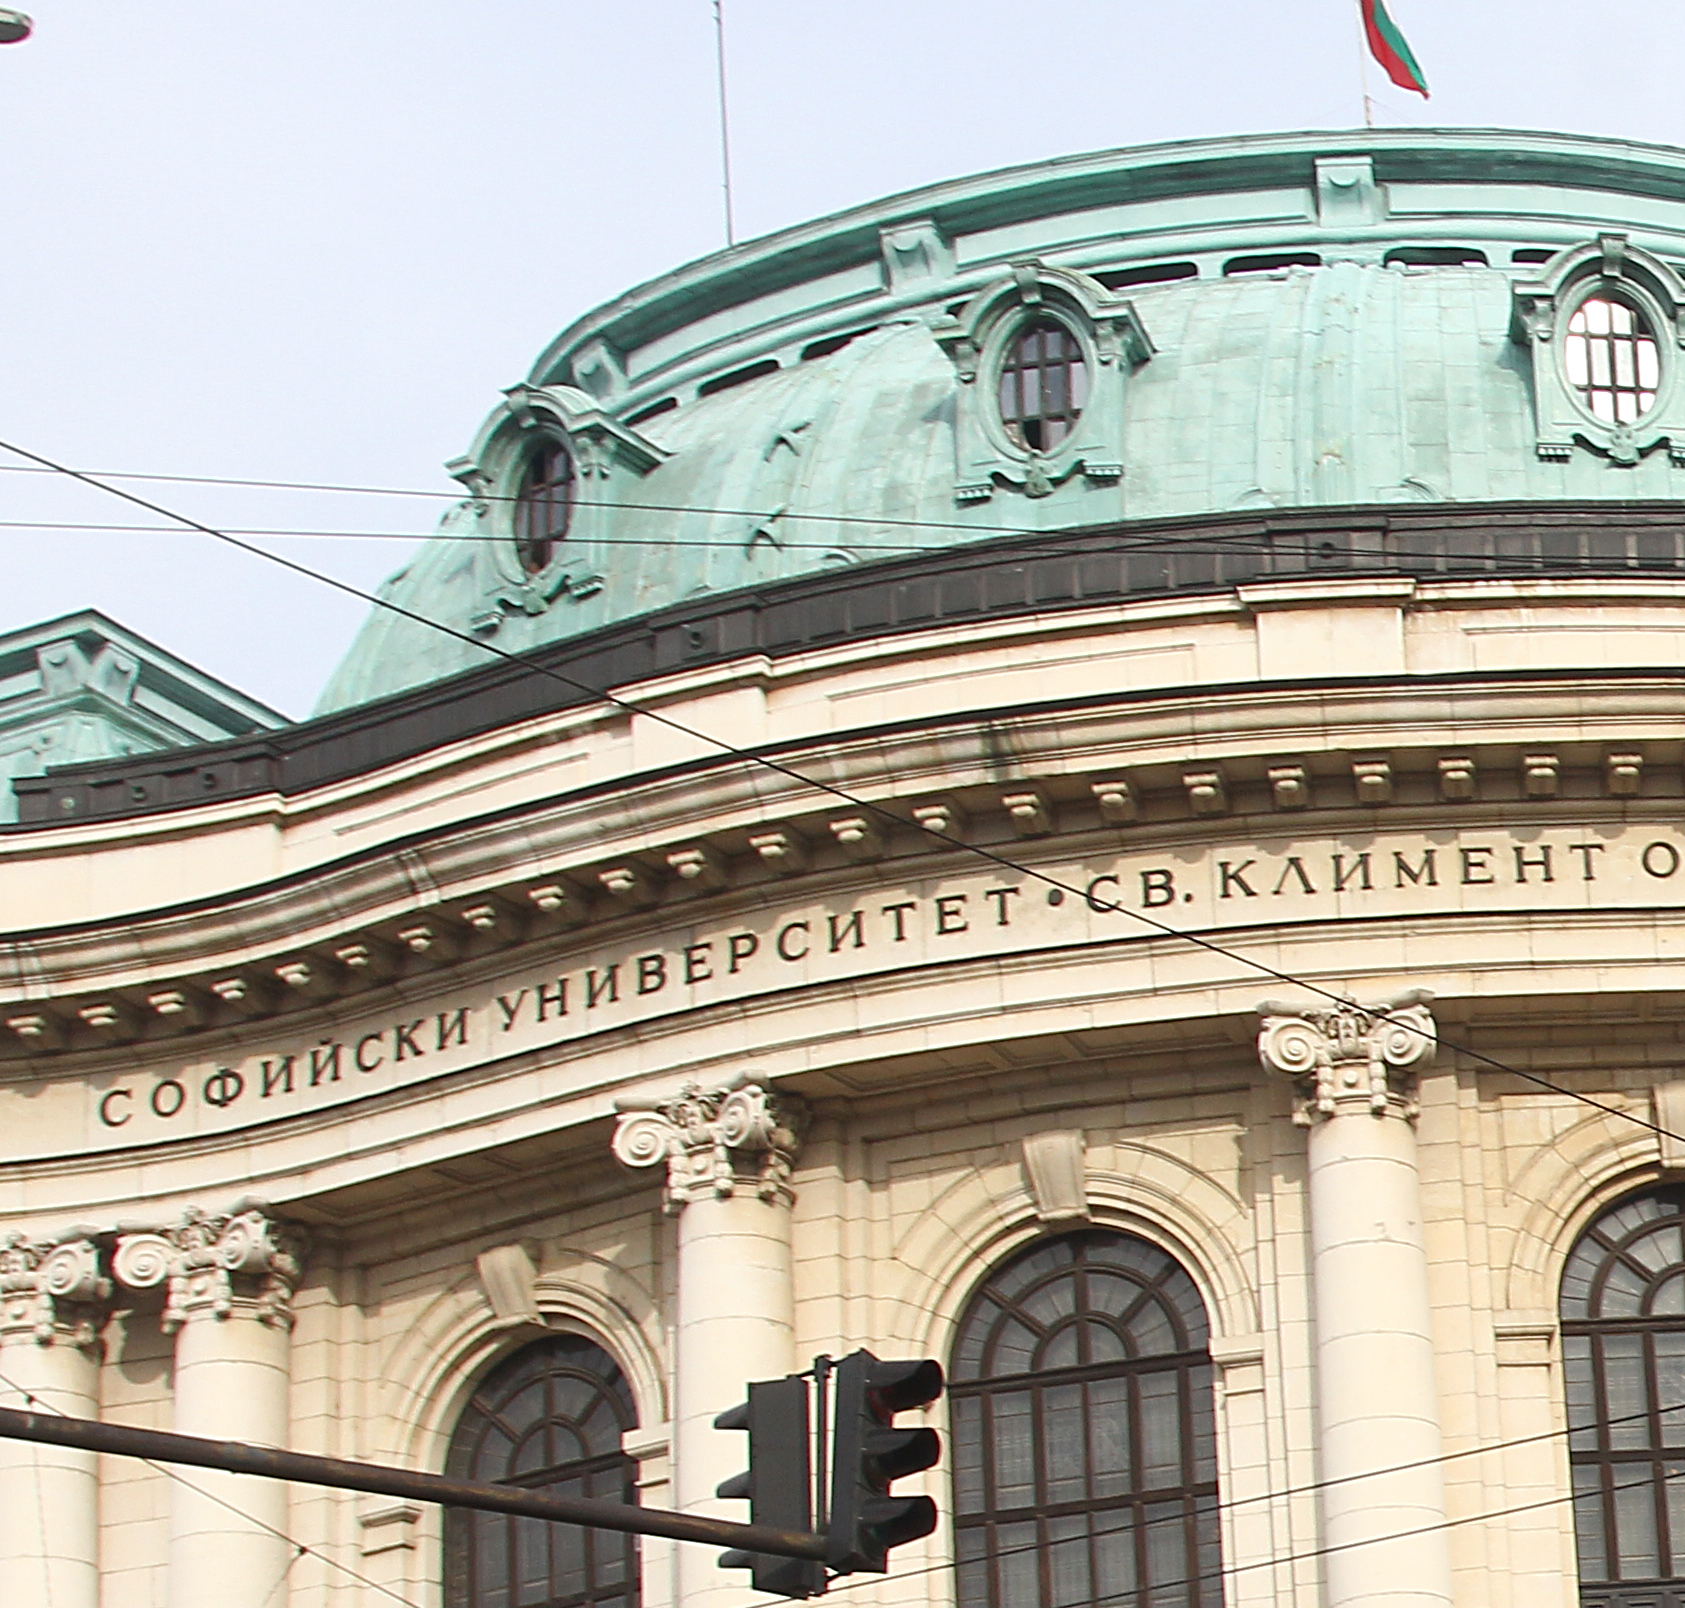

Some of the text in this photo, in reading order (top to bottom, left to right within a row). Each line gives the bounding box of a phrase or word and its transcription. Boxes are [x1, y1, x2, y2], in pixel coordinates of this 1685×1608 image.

[98, 1008, 471, 1128] СОФИЙСКИ
[496, 887, 1023, 1033] УНИВЕРСИТЕТ
[1084, 868, 1194, 914] СВ.
[1217, 843, 1606, 900] КЛИМЕНТ
